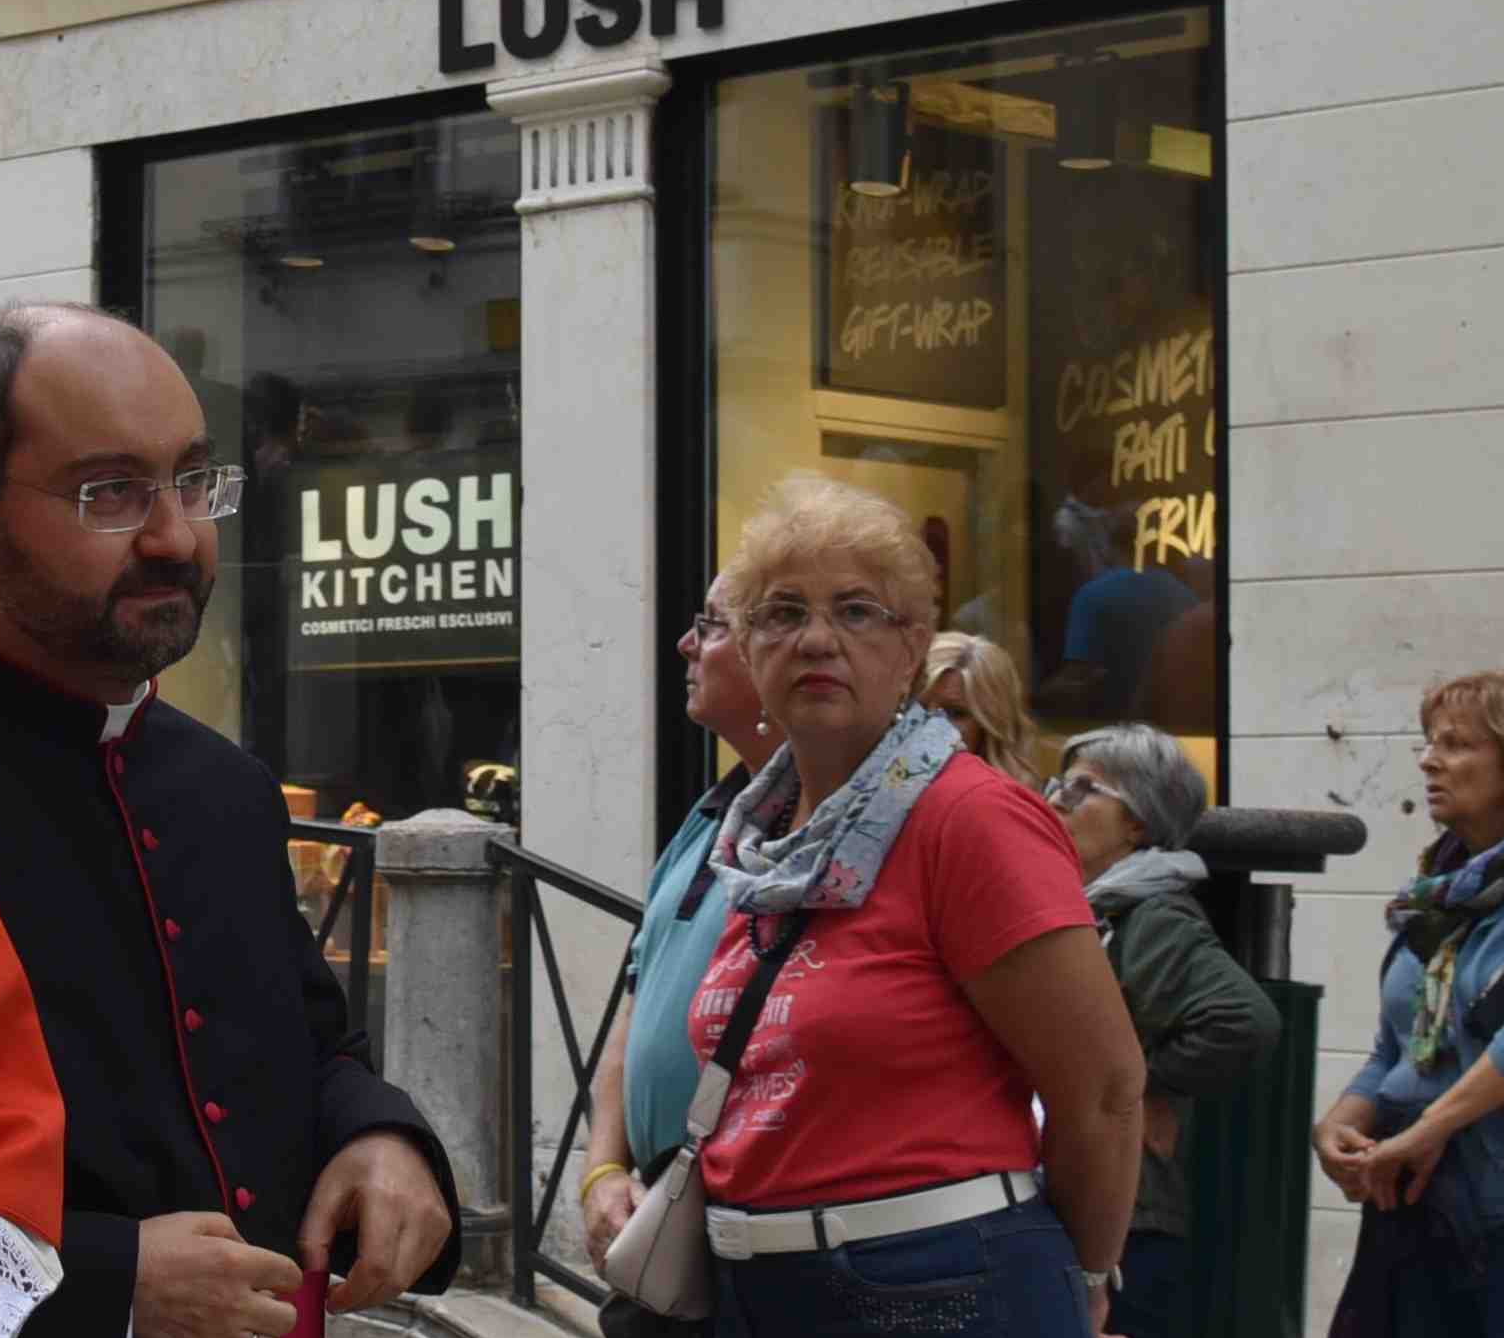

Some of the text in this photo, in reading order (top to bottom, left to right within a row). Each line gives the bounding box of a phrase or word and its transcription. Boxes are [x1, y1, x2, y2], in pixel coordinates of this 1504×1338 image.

[841, 297, 993, 359] GIFT-WRAP
[301, 473, 513, 562] LUSH
[301, 558, 513, 610] KITCHEN
[301, 610, 513, 636] COSMETICI FRESCHI ESCLUSIVI
